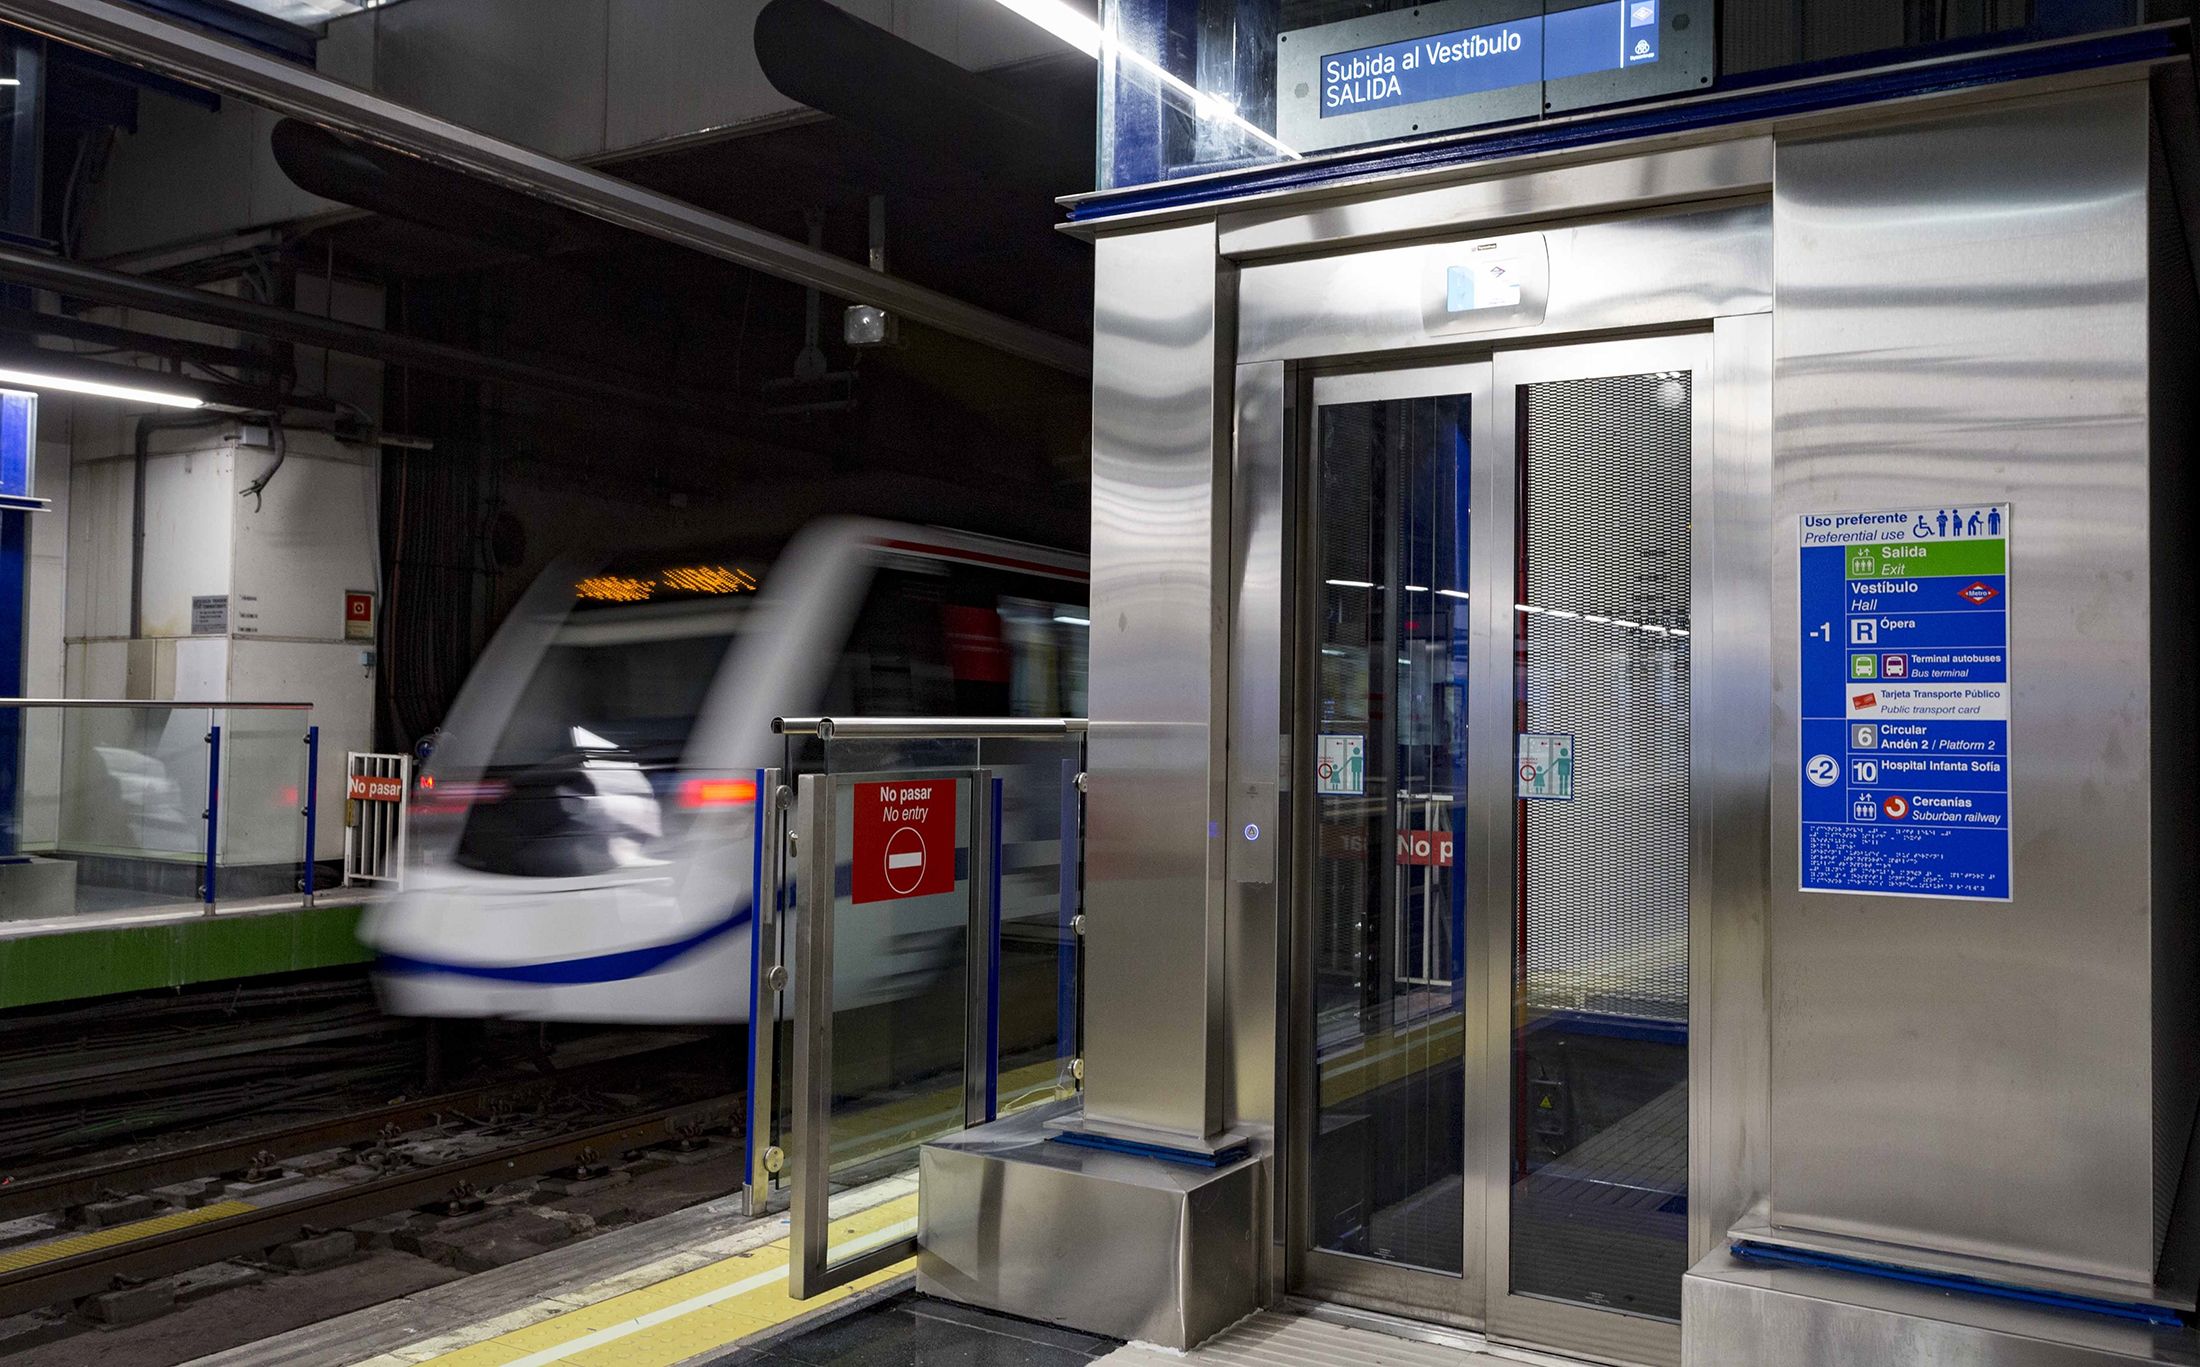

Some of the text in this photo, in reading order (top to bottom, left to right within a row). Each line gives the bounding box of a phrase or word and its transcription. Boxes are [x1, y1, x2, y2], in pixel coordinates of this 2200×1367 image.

[1326, 29, 1521, 83] Subida al Vestíbulo
[1326, 74, 1401, 107] SALIDA
[1805, 512, 1908, 528] Uso preferente
[1804, 529, 1905, 543] Preferential use
[1882, 546, 1927, 559] Salida
[1881, 564, 1905, 575] Exit
[1851, 581, 1918, 594] Vestíbulo
[1851, 599, 1877, 611] Hall
[1880, 616, 1916, 631] Ópera
[1809, 622, 1831, 642] -1
[1856, 623, 1873, 640] R
[1911, 654, 2001, 663] Terminal autobuses
[1911, 668, 1969, 678] Bus terminal
[1881, 688, 2000, 699] Tarjeta Transporte Público
[1880, 705, 1981, 715] Public transport card
[1857, 727, 1873, 746] 6
[1881, 725, 1927, 735] Circular
[1881, 739, 1918, 749] Andén
[1921, 740, 1928, 749] 2
[1939, 740, 1985, 750] Platform
[1988, 741, 1996, 750] 2
[1809, 761, 1833, 779] -2
[1853, 762, 1876, 782] 10
[1881, 760, 2001, 772] Hospital Infanta Sofía
[350, 779, 402, 798] No pasar
[880, 786, 932, 805] No pasar
[1912, 796, 1972, 808] Cercanías
[882, 805, 928, 823] No entry
[1912, 810, 2001, 824] Suburban railway
[1397, 835, 1431, 857] No
